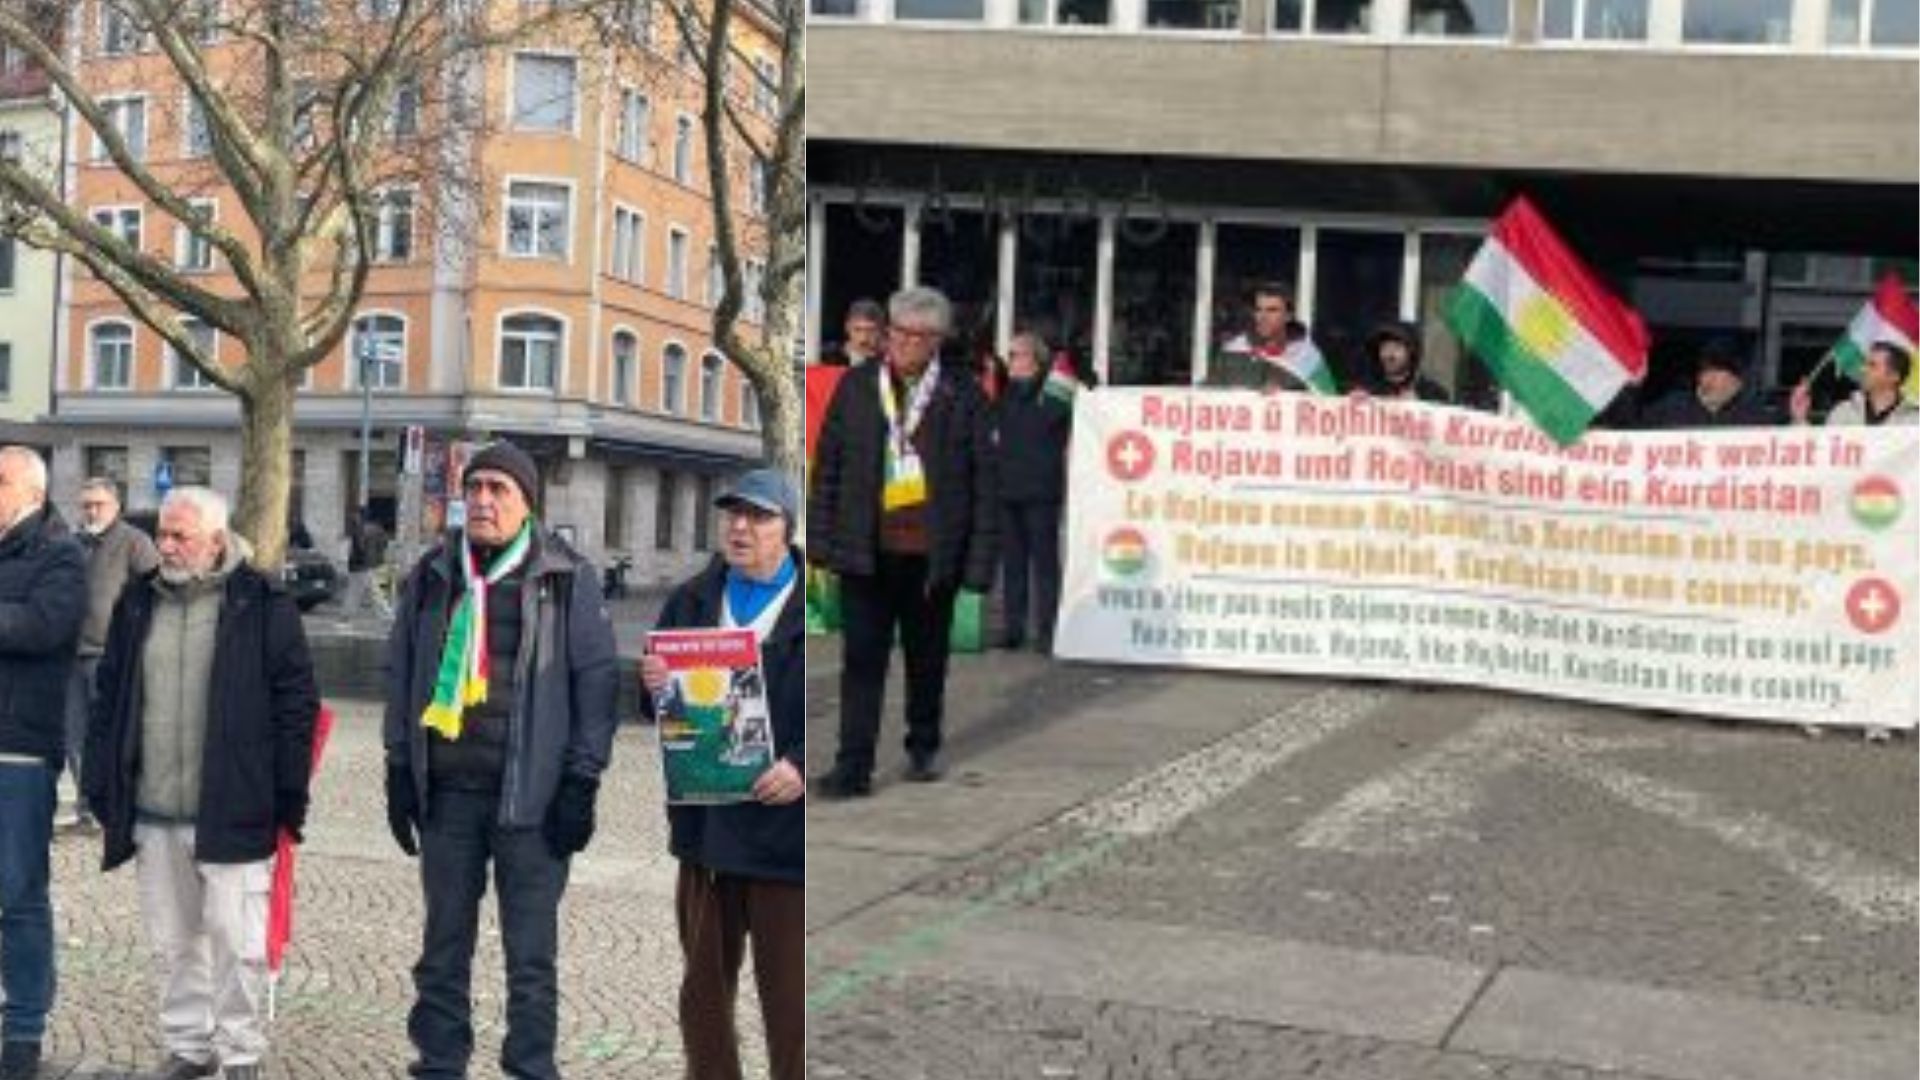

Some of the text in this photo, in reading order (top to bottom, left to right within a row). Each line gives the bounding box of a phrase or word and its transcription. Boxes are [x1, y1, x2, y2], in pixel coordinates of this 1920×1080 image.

[1141, 394, 1253, 436] Rojava
[1645, 437, 1704, 471] yek
[1718, 436, 1815, 466] welat
[1830, 435, 1863, 466] in
[1171, 440, 1282, 481] Rojava
[1295, 448, 1351, 481] und
[1499, 461, 1564, 499] sind
[1578, 473, 1627, 505] ein
[1646, 474, 1821, 514] Kurdistan
[1542, 519, 1680, 559] Kurdistan
